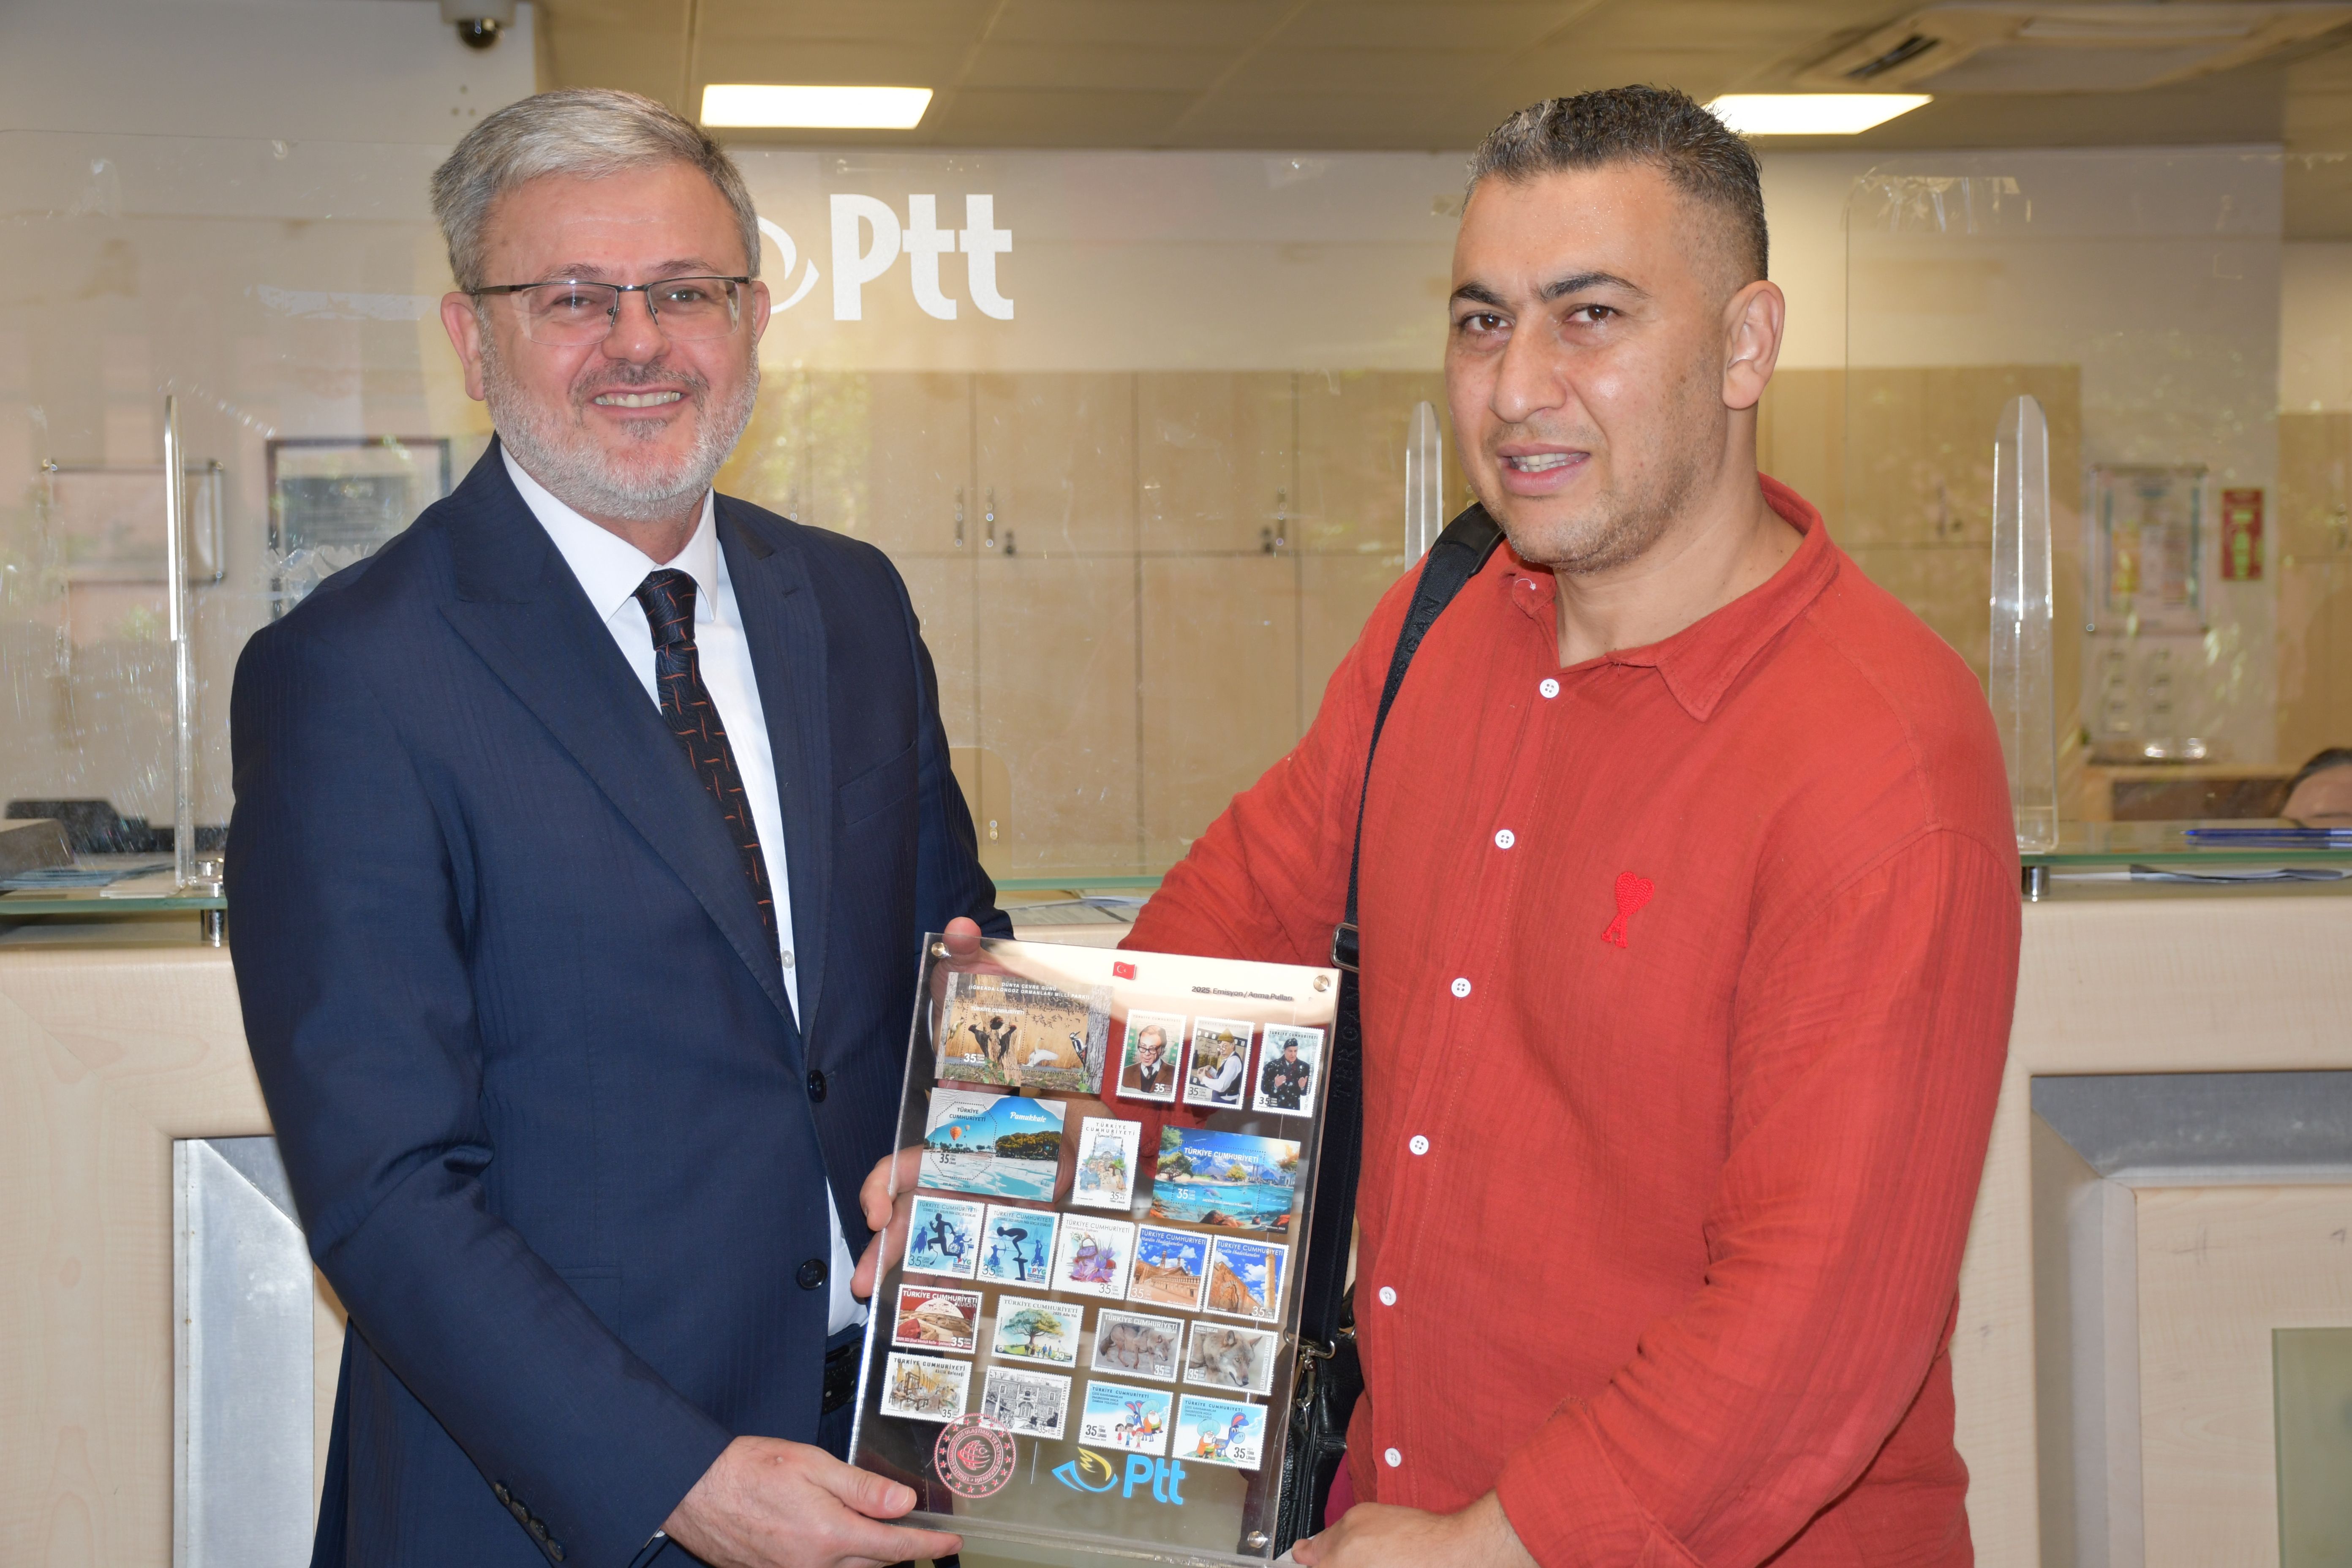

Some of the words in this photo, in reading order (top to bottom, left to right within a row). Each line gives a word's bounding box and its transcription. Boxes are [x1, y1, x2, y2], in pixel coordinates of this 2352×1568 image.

[830, 194, 1013, 320] Ptt
[1213, 988, 1243, 997] Emisyon
[1248, 991, 1269, 999] Anma
[964, 1053, 977, 1063] 35
[1154, 1083, 1165, 1092] 35
[1188, 1087, 1199, 1095] 35
[1259, 1097, 1271, 1105] 35
[949, 1113, 986, 1122] CUMHURİYETİ
[1010, 1111, 1047, 1122] Pamukkale
[1086, 1127, 1135, 1135] CUMHURİYETİ
[939, 1153, 950, 1164] 35
[1184, 1146, 1212, 1157] TÜRKİYE
[1214, 1151, 1259, 1163] CUMHURİYETİ
[1177, 1188, 1189, 1200] 35
[920, 1200, 940, 1209] TÜRKİYE
[942, 1204, 977, 1213] CUMHURİYETİ
[994, 1210, 1014, 1218] TÜRKİYE
[1016, 1213, 1052, 1222] CUMHURİYETİ
[1066, 1219, 1089, 1228] TÜRKİYE
[1090, 1223, 1130, 1233] CUMHURİYETİ
[1141, 1230, 1164, 1239] TÜRKİYE
[1166, 1234, 1206, 1245] CUMHURİYETİ
[1218, 1241, 1241, 1250] TÜRKİYE
[1243, 1245, 1284, 1256] CUMHURİYETİ
[908, 1255, 922, 1266] 35
[982, 1264, 996, 1276] 35
[1099, 1283, 1111, 1294] 35
[1131, 1288, 1144, 1298] 35
[903, 1289, 931, 1298] TÜRKİYE
[932, 1293, 978, 1304] CUMHURİYETİ
[1004, 1299, 1032, 1307] TÜRKİYE
[1033, 1303, 1078, 1314] CUMHURİYETİ
[1252, 1306, 1265, 1317] 35
[1105, 1313, 1132, 1323] TÜRKİYE
[1134, 1318, 1178, 1330] CUMHURİYETİ
[951, 1337, 964, 1347] 35
[1054, 1352, 1064, 1361] 29
[894, 1357, 920, 1366] TÜRKİYE
[923, 1361, 965, 1372] CUMHURİYETİ
[1154, 1365, 1165, 1376] 35
[1188, 1369, 1199, 1379] 35
[1260, 1358, 1269, 1390] CUMHURİYETİ
[1116, 1390, 1149, 1399] CUMHURİYETİ
[942, 1409, 952, 1418] 35
[1209, 1404, 1243, 1412] CUMHURİYETİ
[1056, 1402, 1065, 1436] CUMHURİYETİ
[1085, 1424, 1097, 1436] 35
[1233, 1447, 1246, 1459] 35
[1123, 1454, 1185, 1505] Ptt
